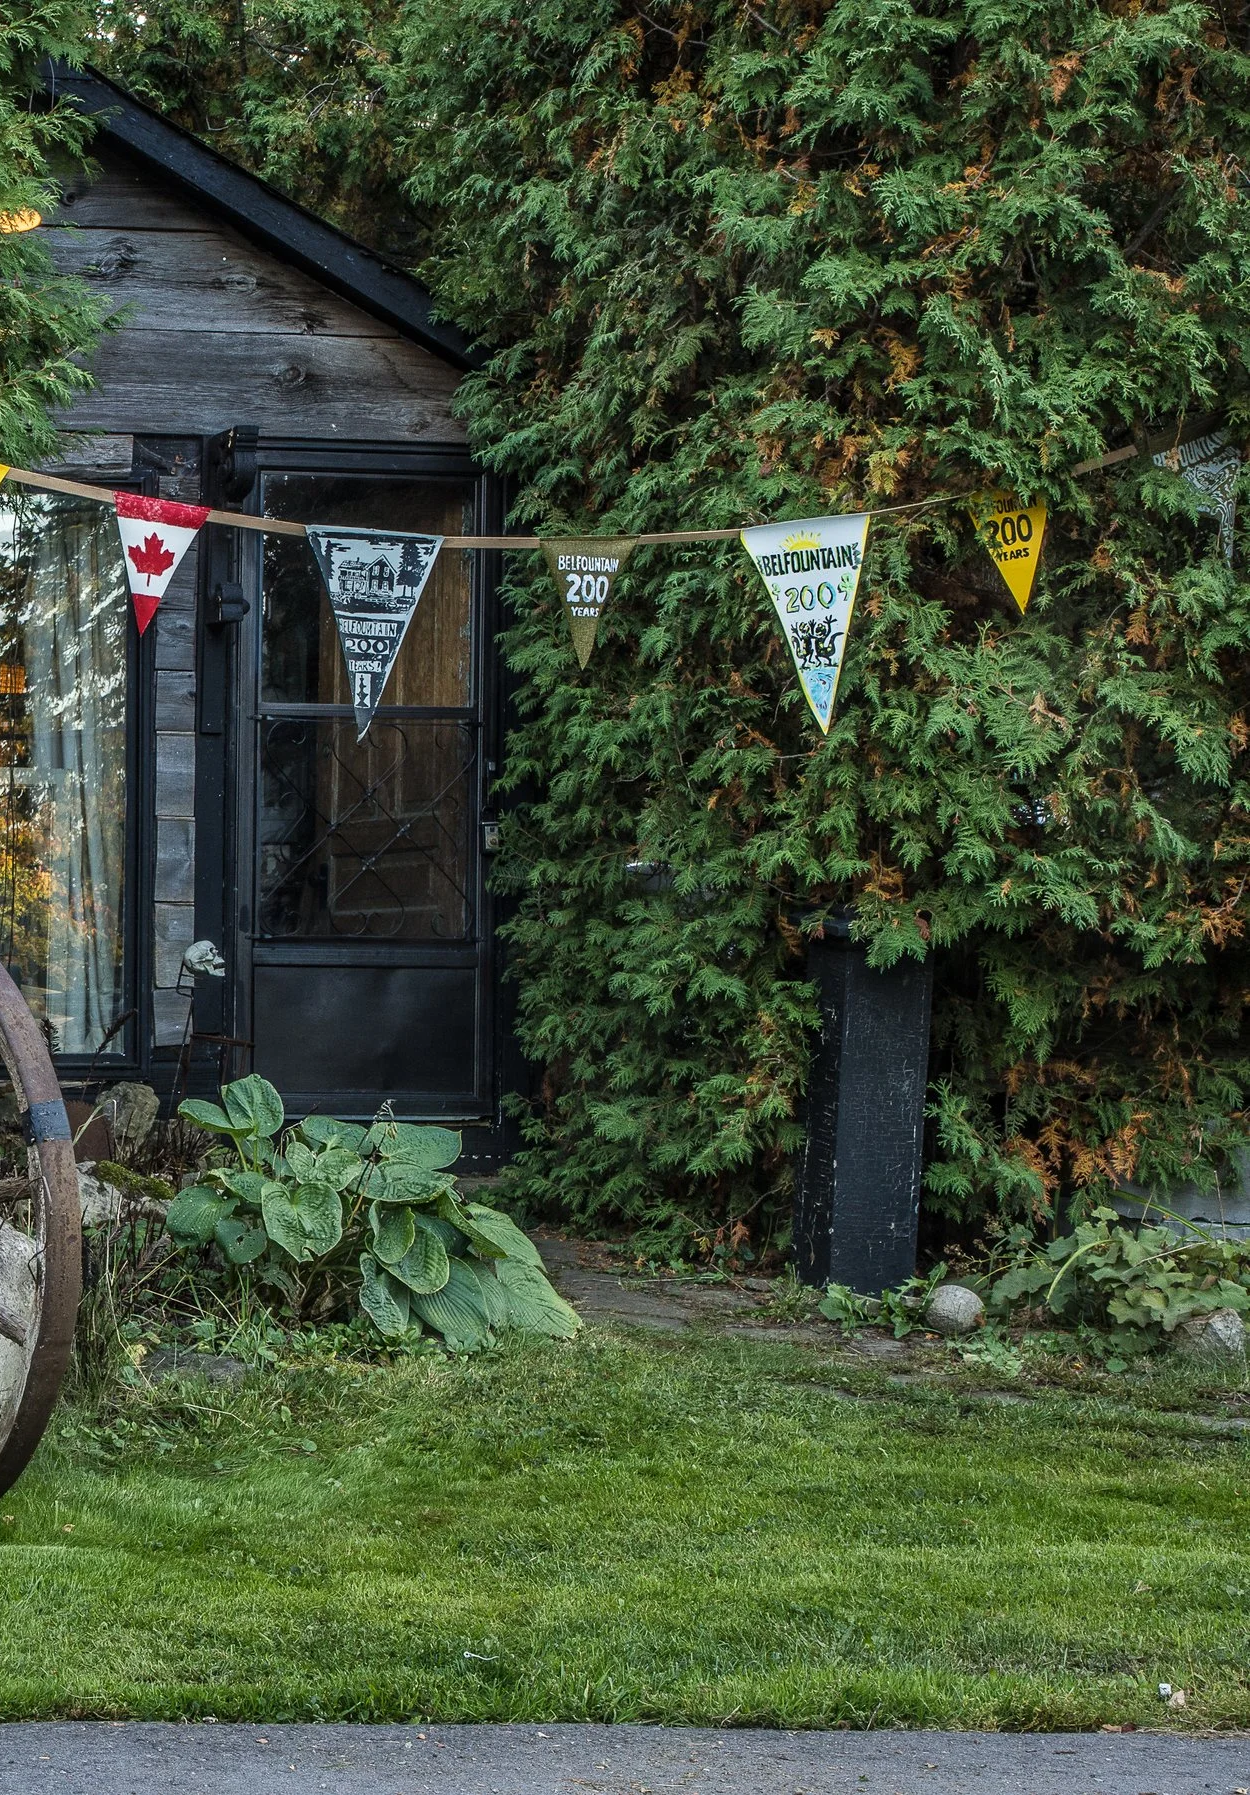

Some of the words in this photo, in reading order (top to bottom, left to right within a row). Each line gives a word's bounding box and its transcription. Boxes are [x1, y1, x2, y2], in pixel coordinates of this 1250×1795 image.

[761, 545, 854, 576] BELFOUNTAIN
[996, 547, 1030, 562] YEARS
[558, 555, 620, 573] BELFOUNTAIN
[565, 573, 609, 603] 200
[784, 581, 837, 613] 200
[570, 606, 600, 617] YEARS
[345, 637, 390, 655] 200
